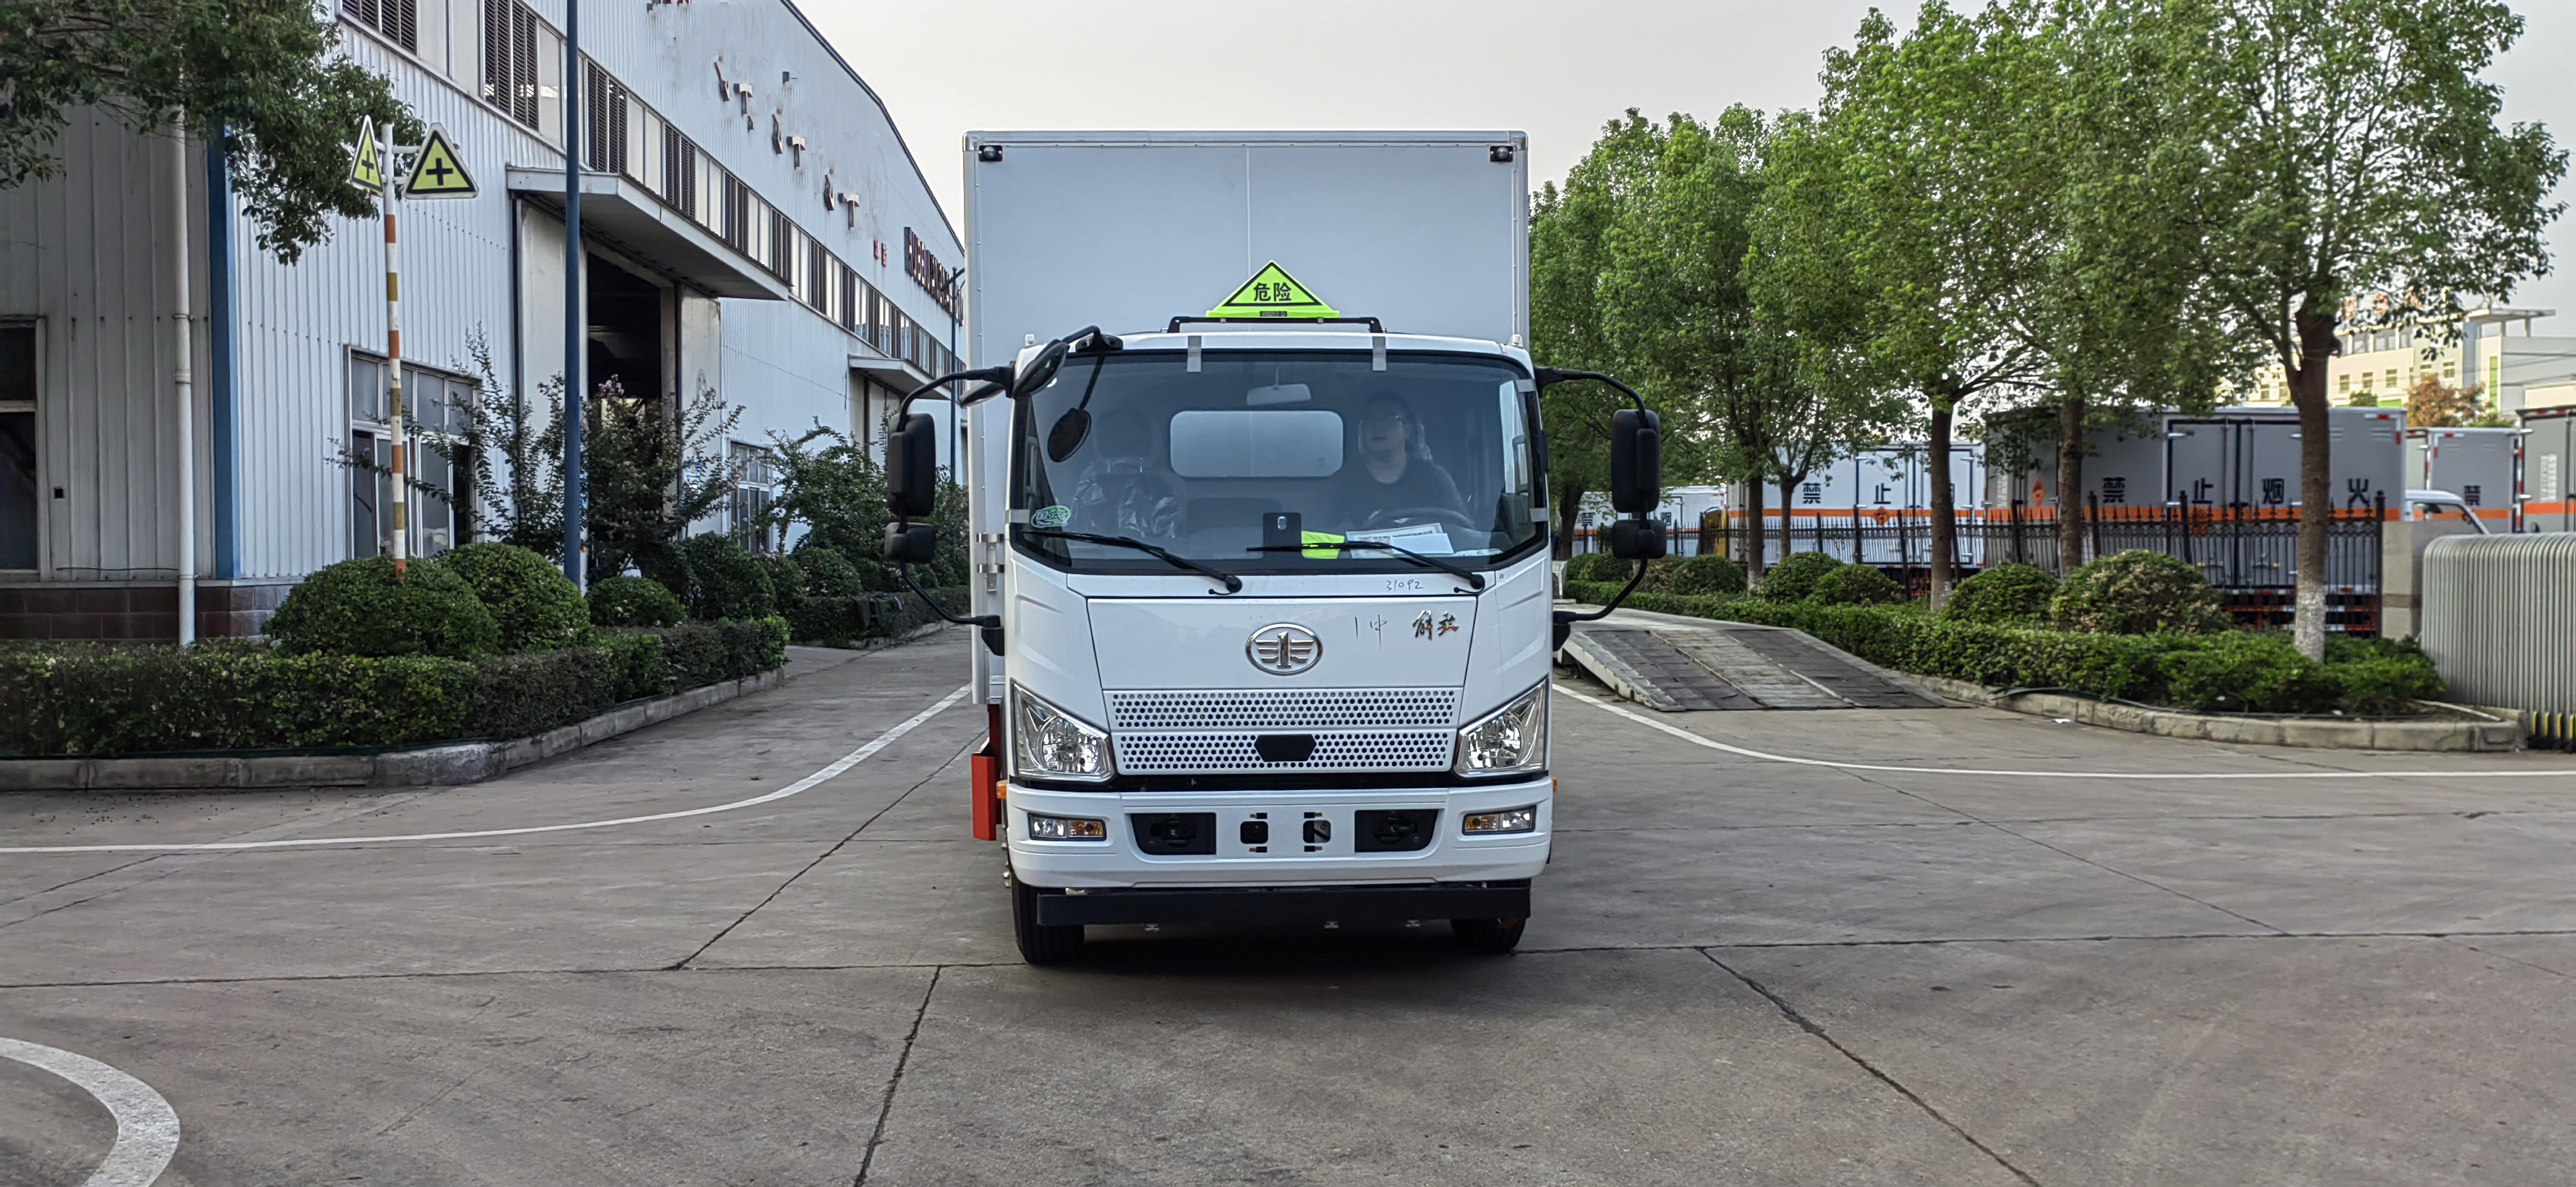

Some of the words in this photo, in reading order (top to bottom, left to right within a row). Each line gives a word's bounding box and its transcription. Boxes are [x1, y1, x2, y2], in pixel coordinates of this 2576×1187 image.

[1253, 282, 1292, 302] 危险
[1803, 482, 1821, 504] 禁
[1874, 483, 1891, 504] 止
[2102, 477, 2125, 504] 禁
[2192, 477, 2214, 504] 止
[2262, 478, 2285, 504] 烟
[2348, 478, 2370, 505] 火
[2464, 485, 2481, 505] 禁
[1036, 510, 1064, 521] 国六
[1385, 579, 1424, 592] 31092
[1413, 610, 1459, 641] 解放
